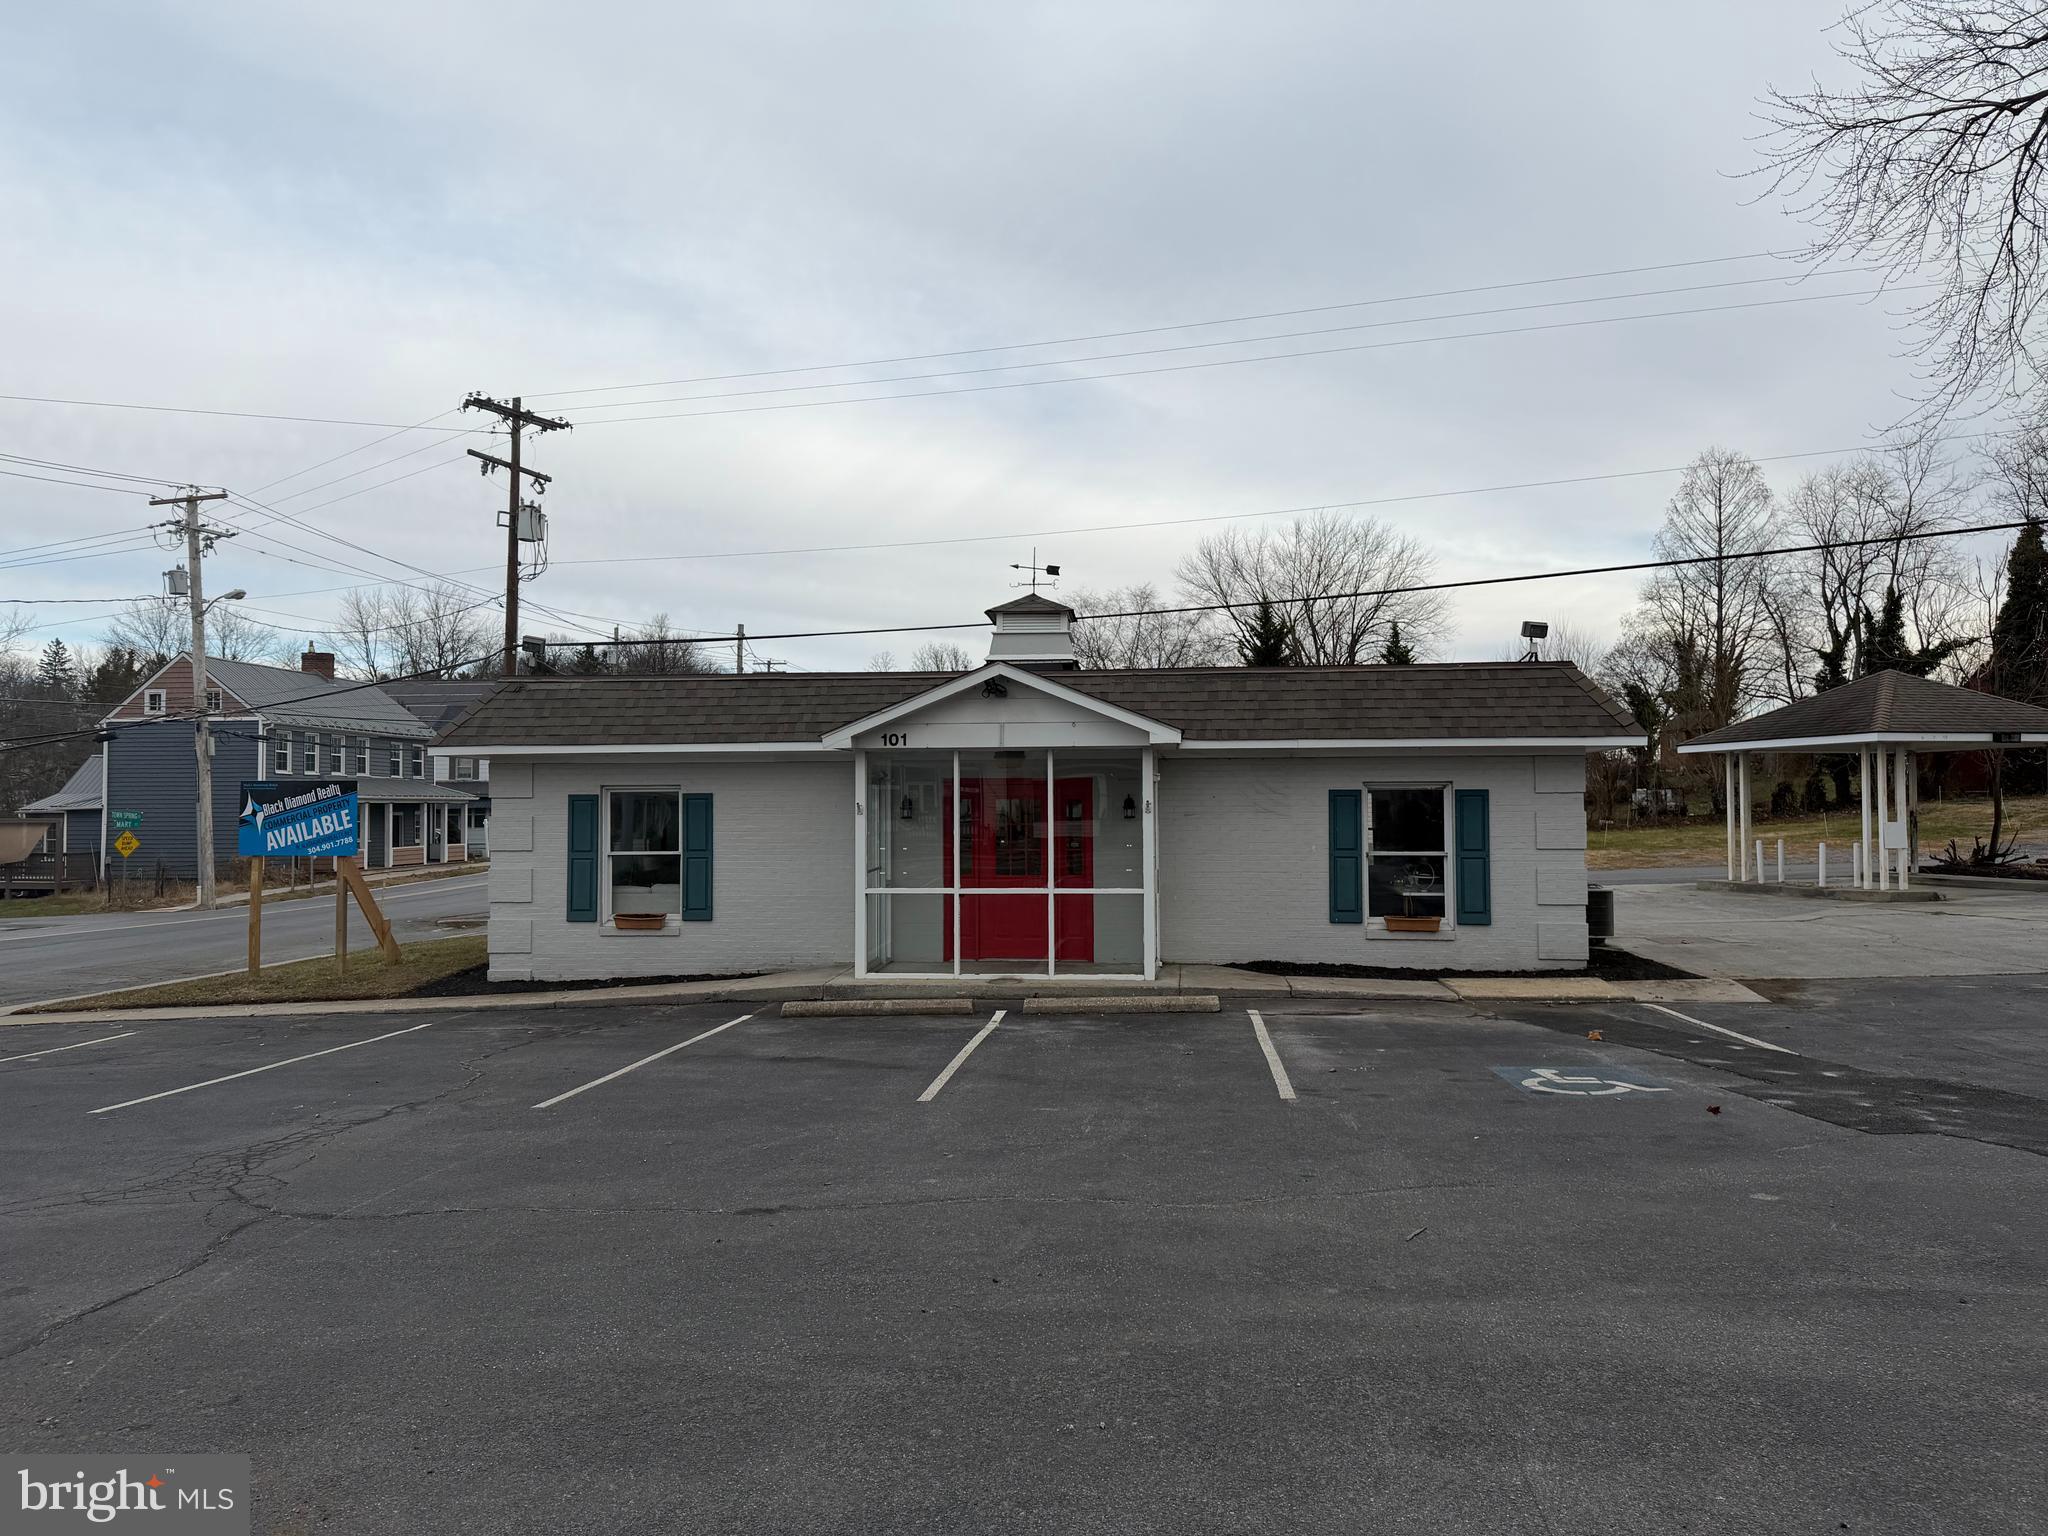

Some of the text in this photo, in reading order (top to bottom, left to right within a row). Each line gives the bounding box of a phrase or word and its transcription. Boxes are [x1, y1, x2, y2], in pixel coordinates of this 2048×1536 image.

[881, 733, 906, 746] 101
[262, 783, 342, 817] Black Diamond Realty
[263, 797, 351, 831] COMMERCIAL PROPERTY
[267, 809, 353, 851] AVAILABLE
[307, 836, 354, 855] 304.901.7788
